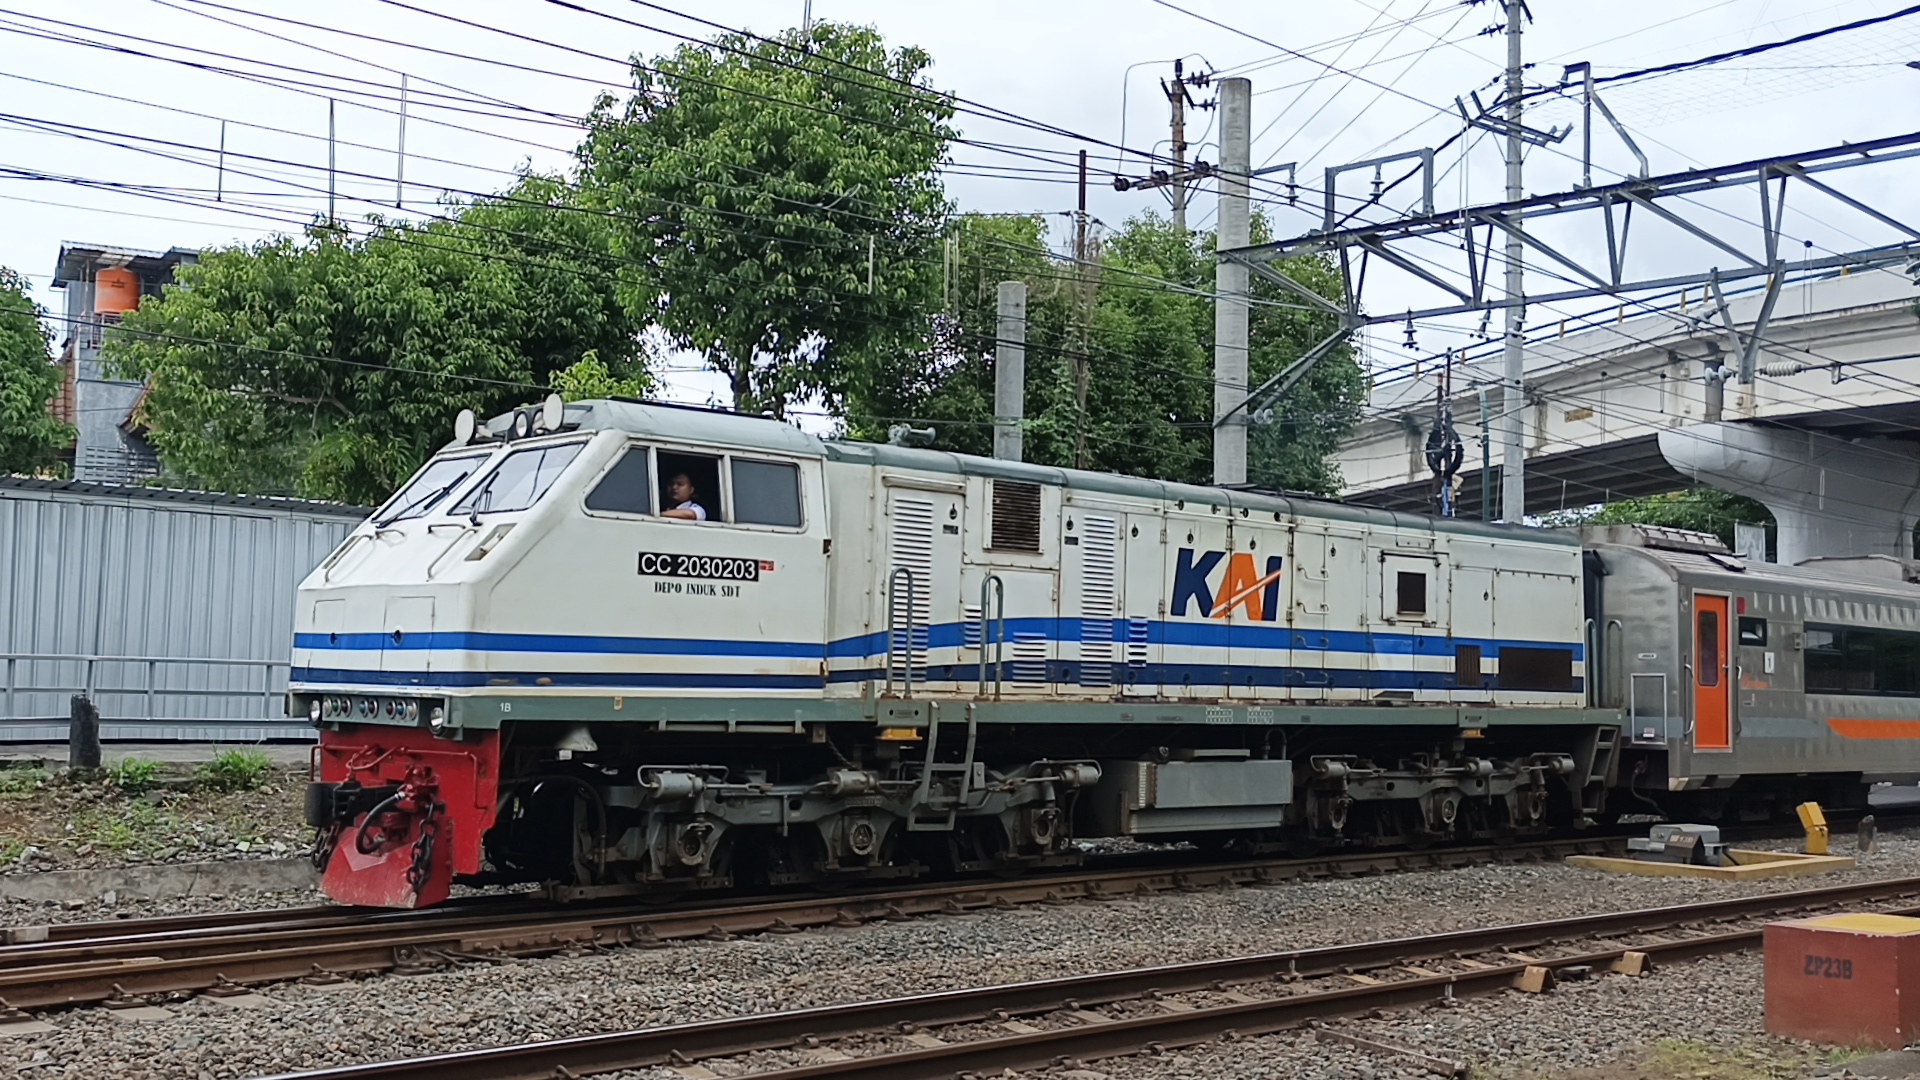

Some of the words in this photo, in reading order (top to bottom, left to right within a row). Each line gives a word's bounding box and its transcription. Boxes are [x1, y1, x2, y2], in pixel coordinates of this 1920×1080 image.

[641, 553, 671, 574] CC
[677, 556, 756, 579] 2030203
[654, 581, 682, 594] DEPO
[686, 583, 717, 596] INDUK
[721, 585, 741, 598] SDT
[1170, 547, 1283, 622] KAI
[500, 702, 511, 712] 1B
[1804, 954, 1853, 980] ZP23B
